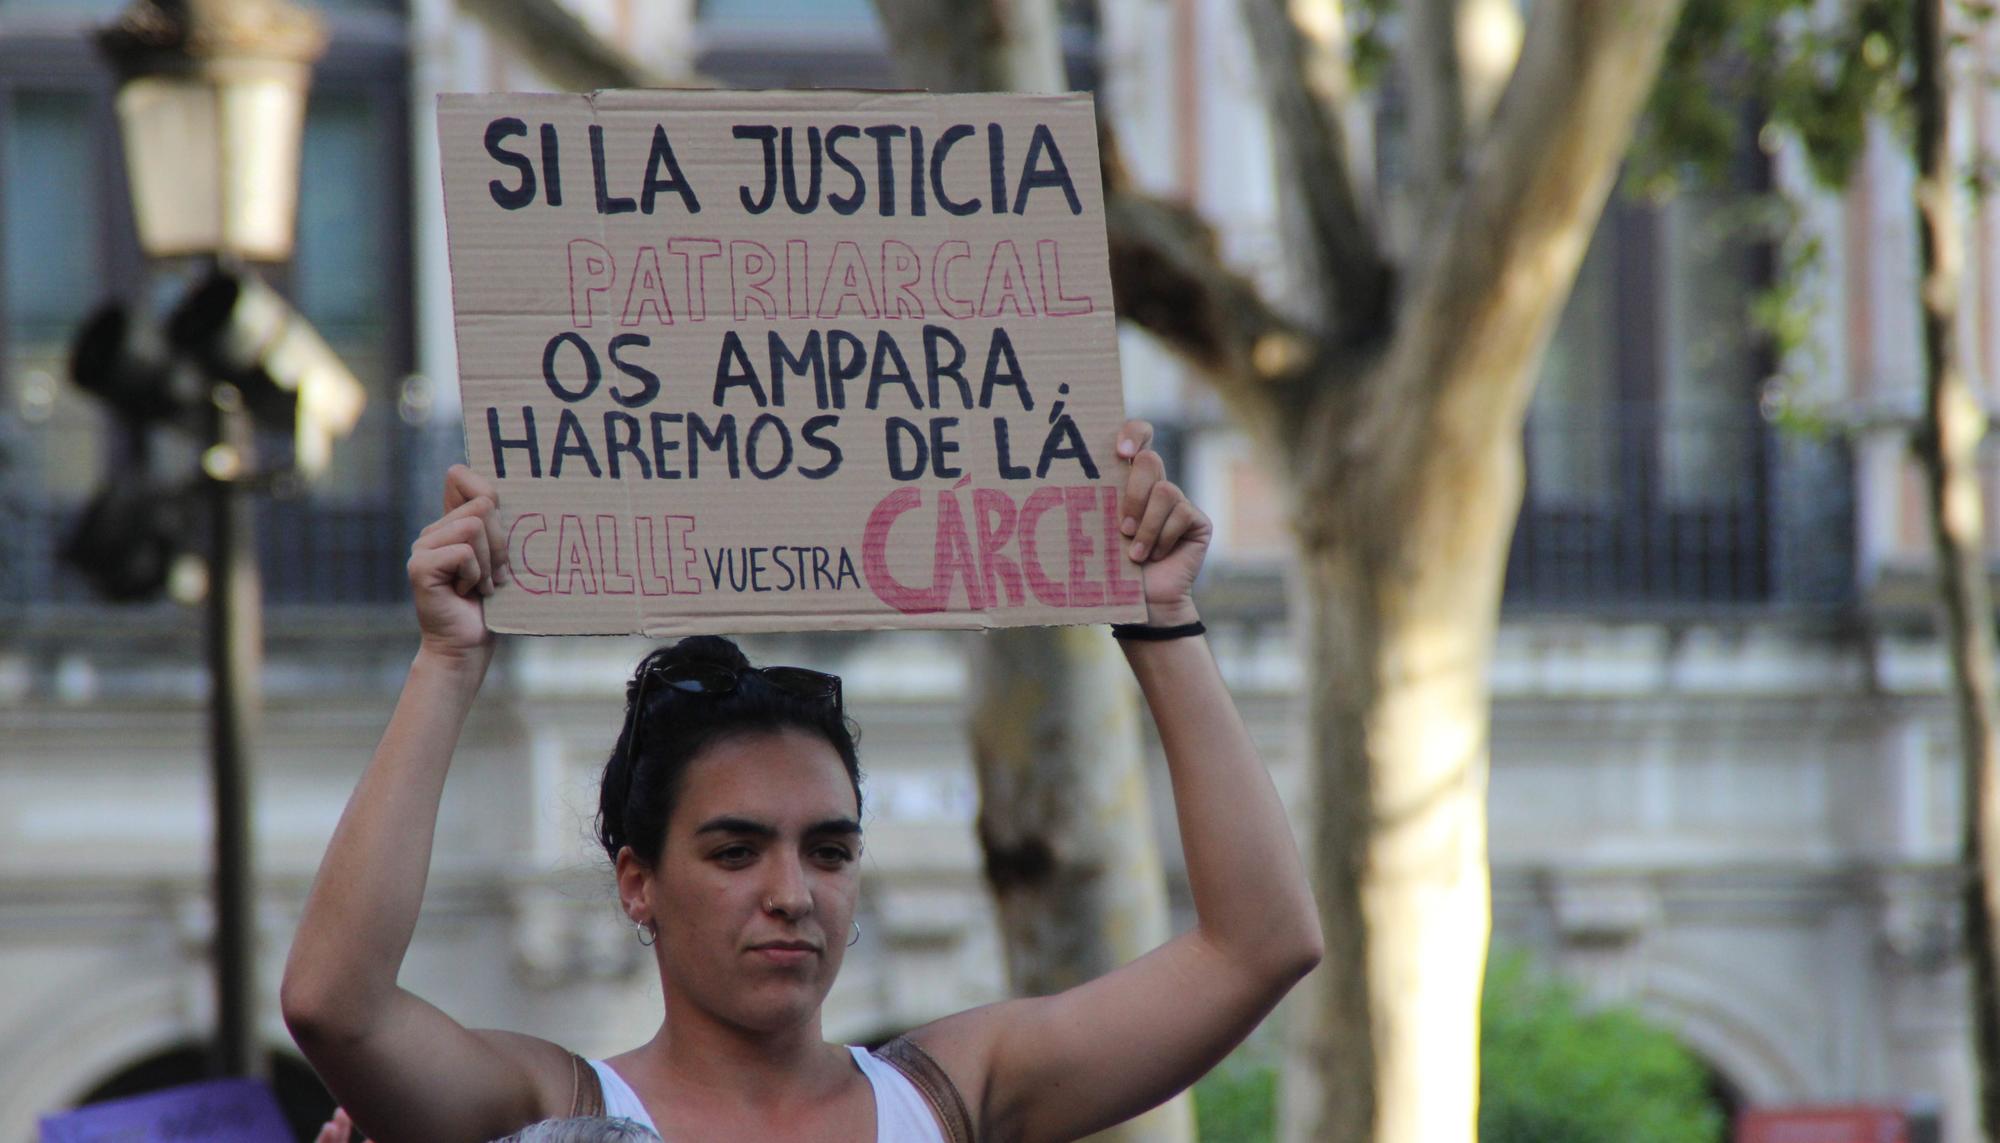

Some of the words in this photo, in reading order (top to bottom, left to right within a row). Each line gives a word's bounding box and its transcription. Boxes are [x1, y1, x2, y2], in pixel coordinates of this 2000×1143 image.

[483, 116, 563, 211] SI
[588, 124, 702, 216] LA
[731, 123, 1083, 217] JUSTICIA
[567, 237, 1093, 328] PATRIARCAL
[541, 331, 661, 409] OS
[486, 405, 844, 481] HAREMOS
[885, 416, 962, 482] DE
[506, 513, 701, 596] CALLE
[703, 546, 861, 593] VUESTRA
[861, 471, 1141, 615] CÁRCEL
